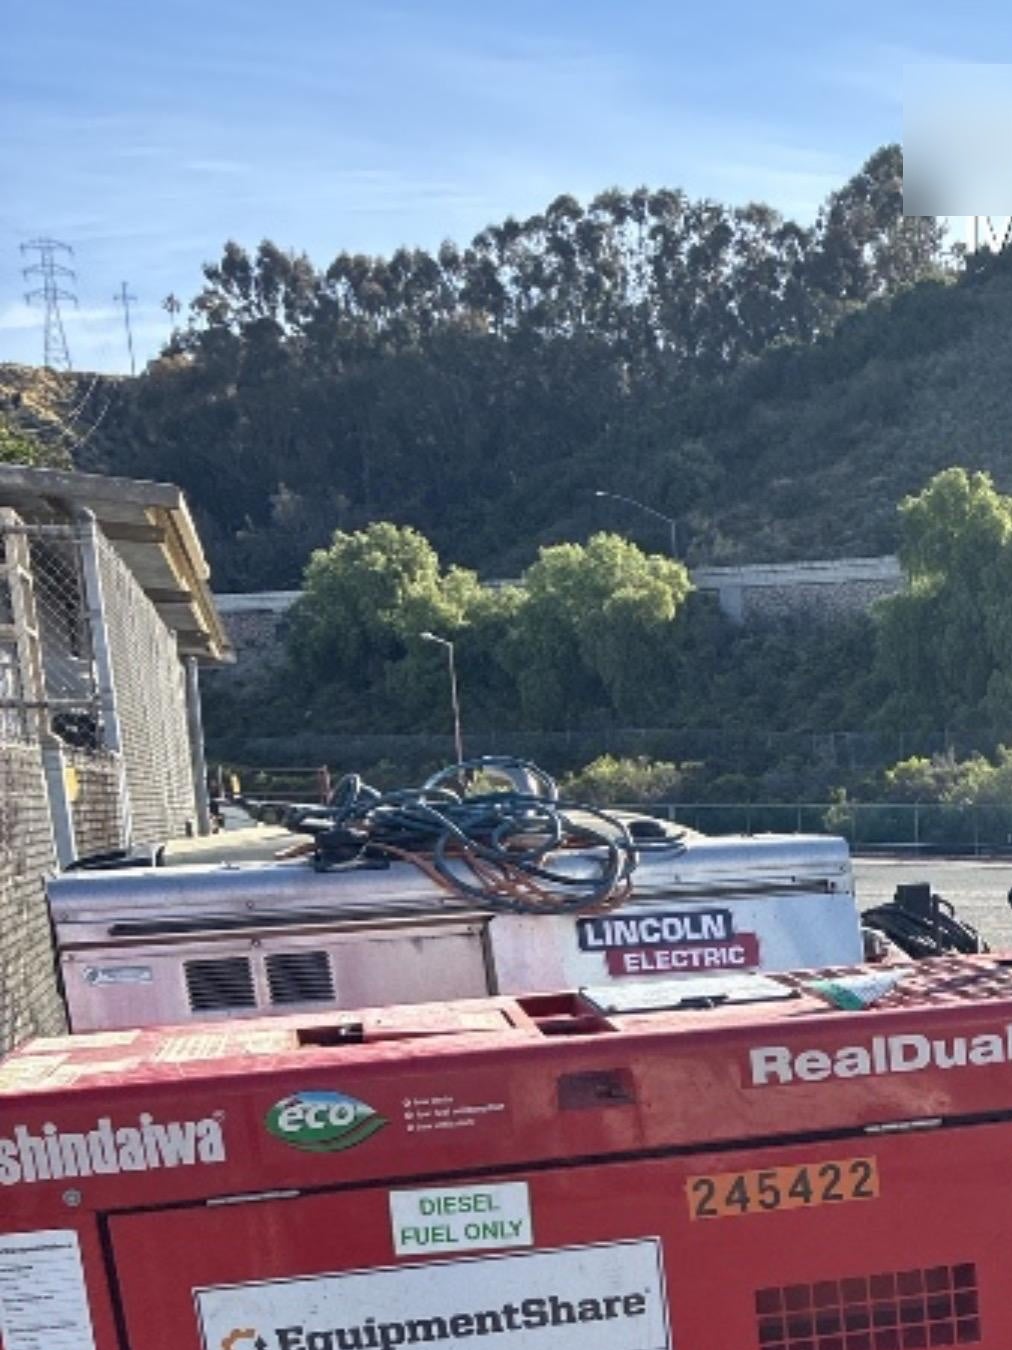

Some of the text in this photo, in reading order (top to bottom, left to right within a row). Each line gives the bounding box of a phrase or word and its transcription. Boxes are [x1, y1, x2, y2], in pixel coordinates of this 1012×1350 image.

[584, 914, 724, 947] LINCOLN
[623, 947, 745, 972] ELECTRIC
[278, 1101, 355, 1132] eco
[0, 1112, 226, 1186] shindaiwa
[692, 1160, 874, 1217] 245422
[418, 1193, 500, 1216] DIESEL
[401, 1219, 523, 1246] FUEL ONLY
